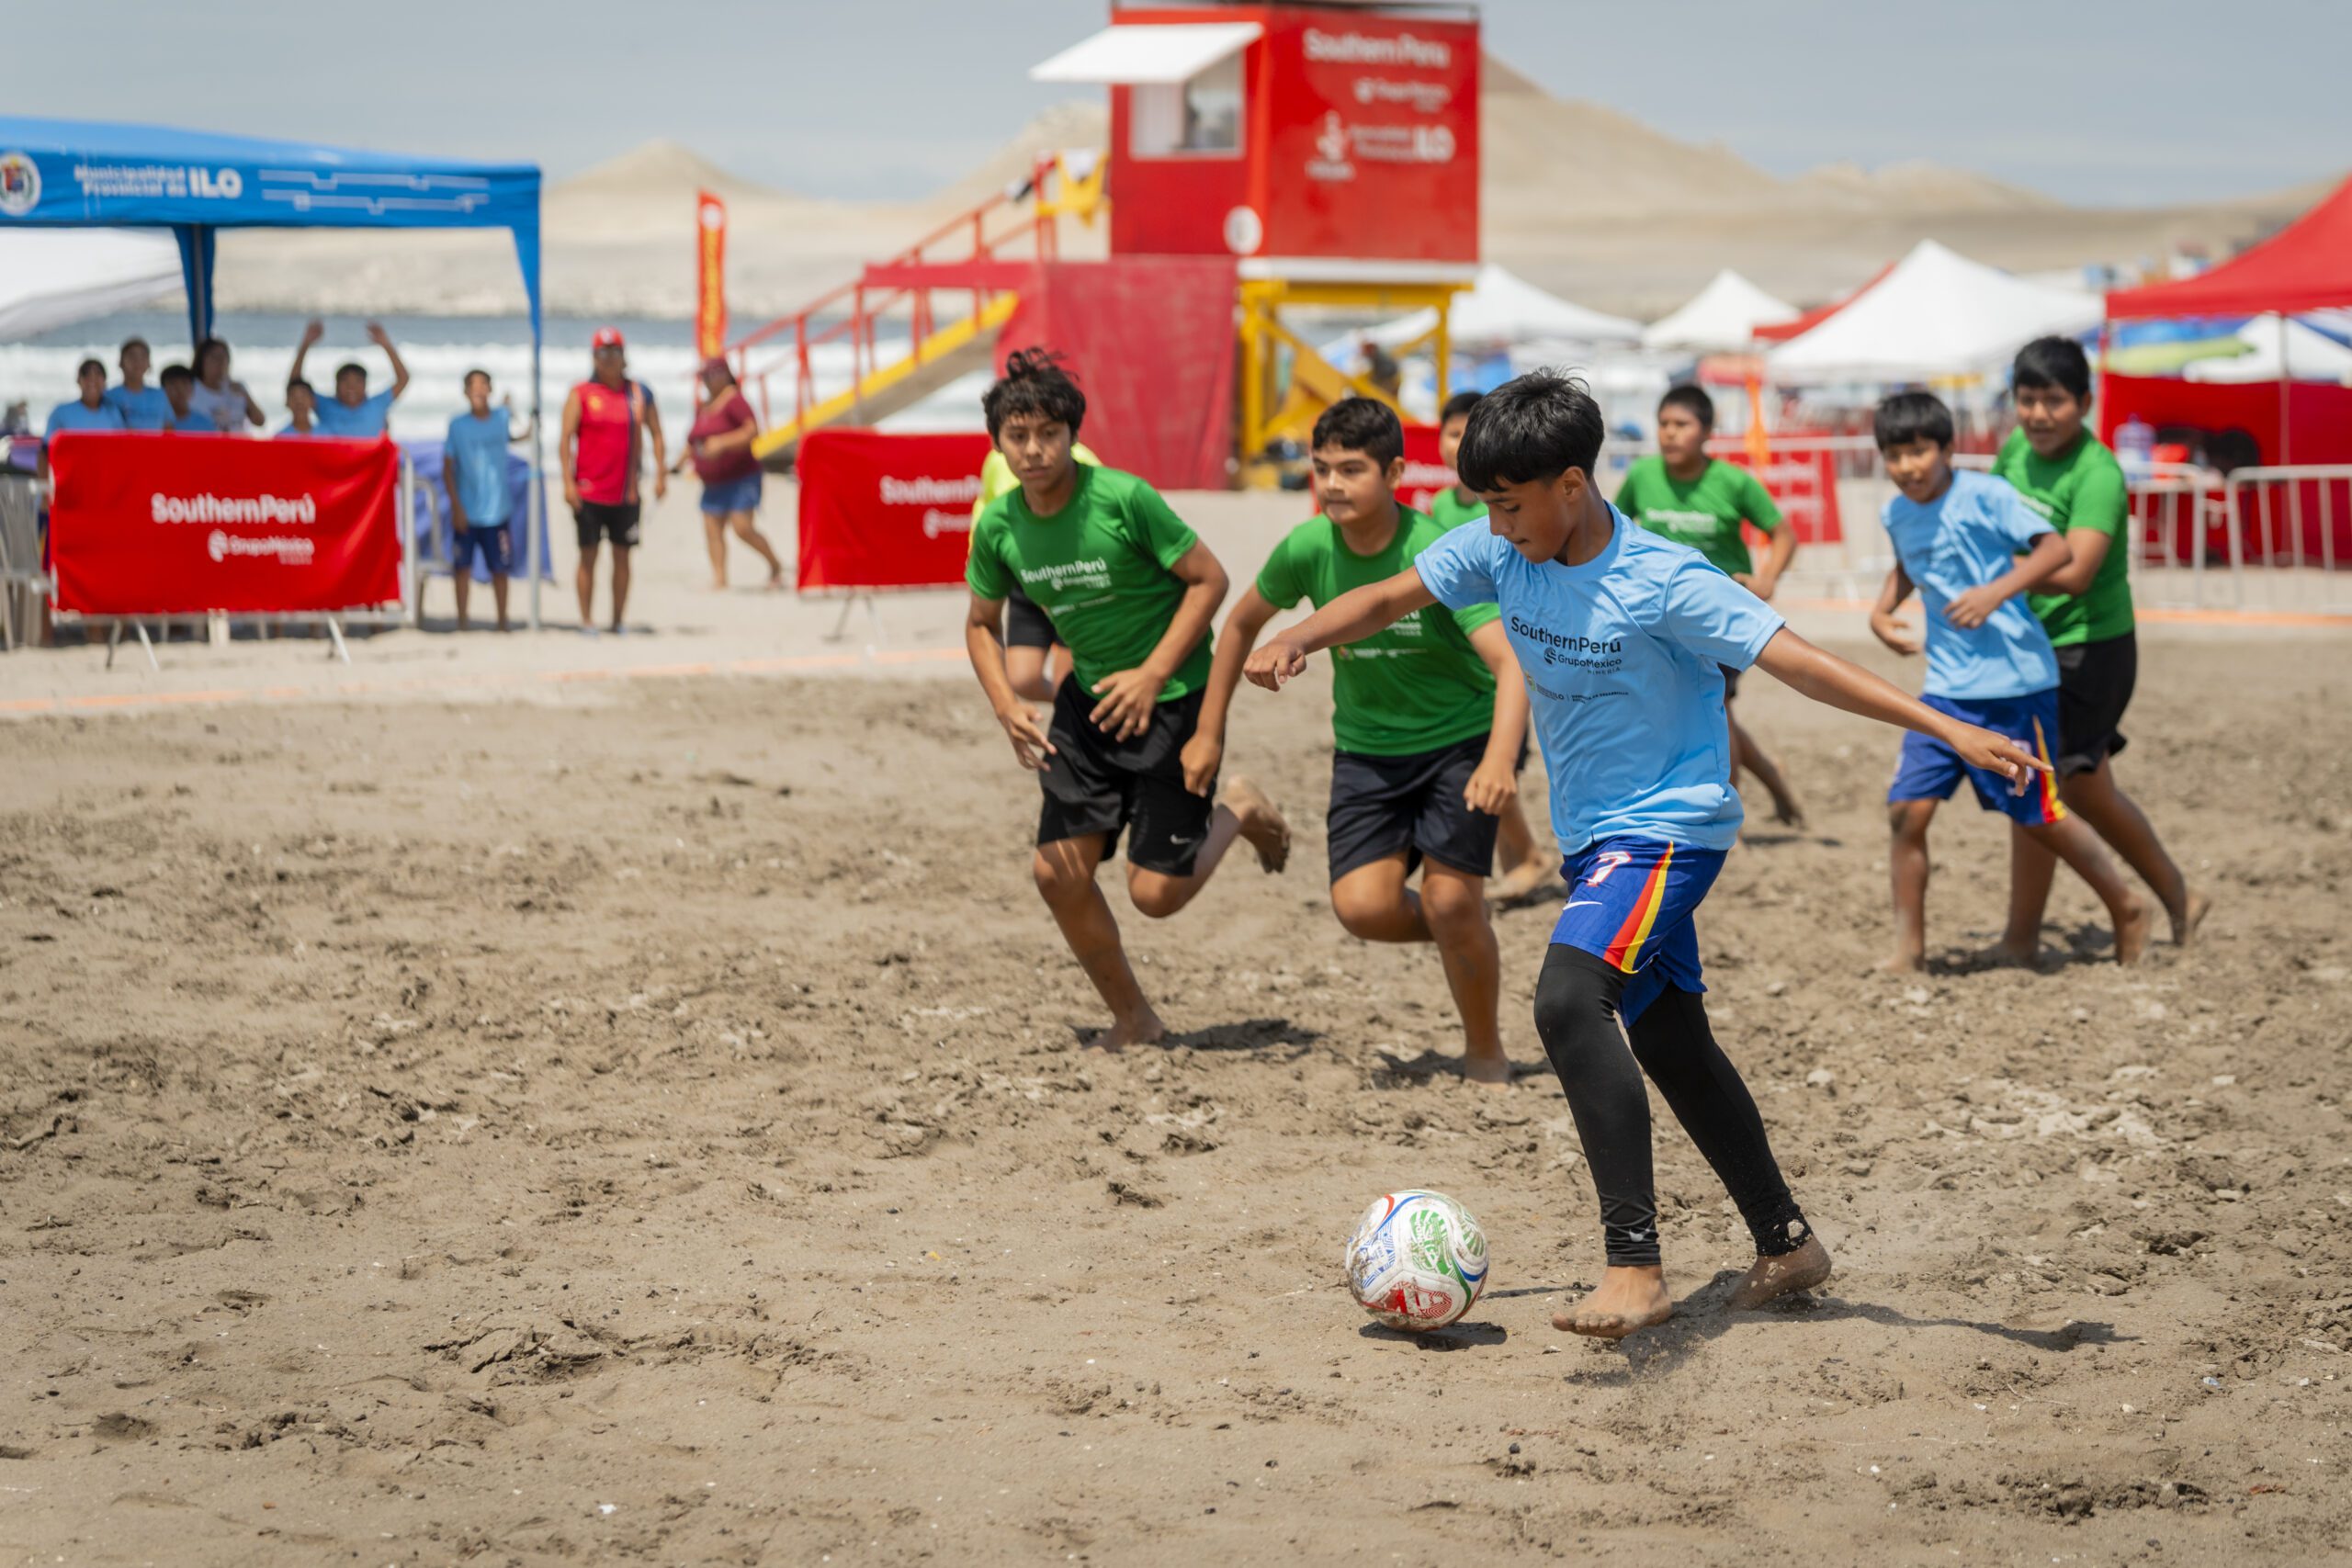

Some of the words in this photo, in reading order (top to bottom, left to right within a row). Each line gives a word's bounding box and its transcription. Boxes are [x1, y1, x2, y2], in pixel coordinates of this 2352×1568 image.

[188, 166, 243, 199] ILO
[151, 492, 316, 524] SouthernPerú
[1020, 557, 1107, 583] SouthernPerú
[1511, 616, 1622, 653] SouthernPerú
[1557, 654, 1623, 669] GrupoMéxico
